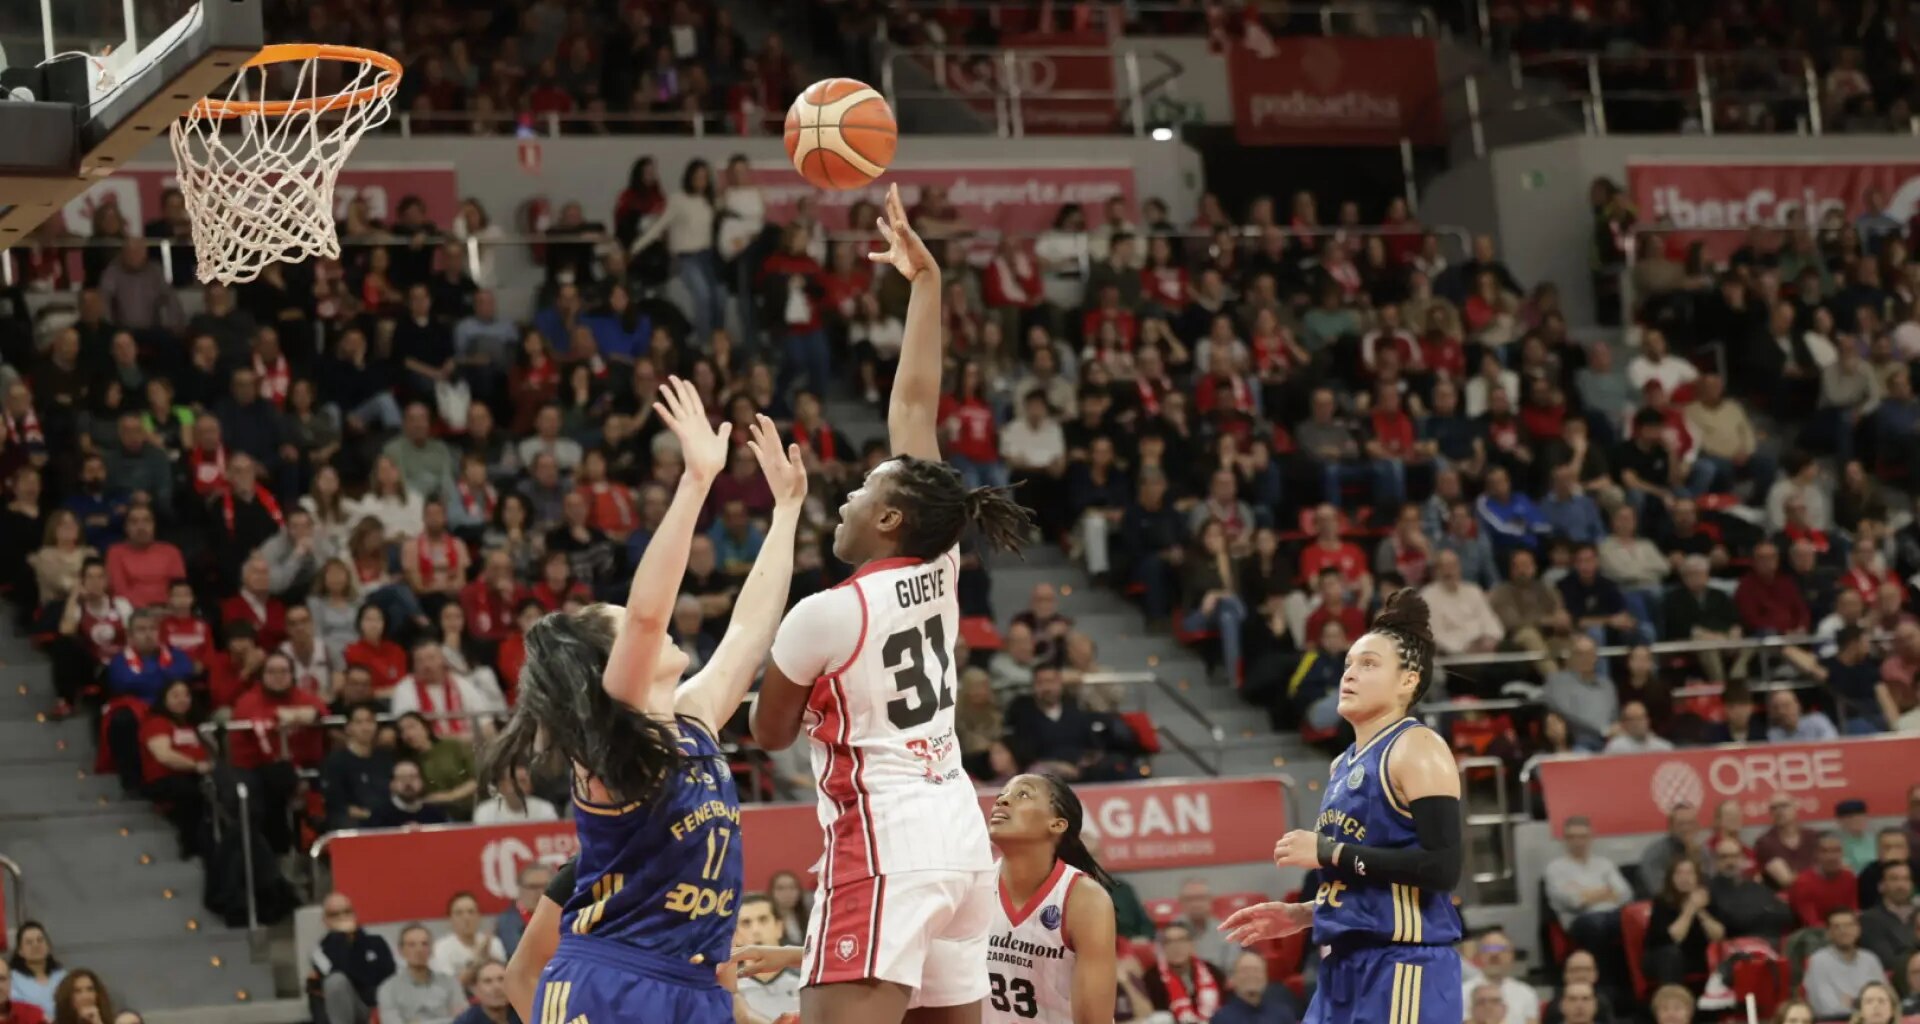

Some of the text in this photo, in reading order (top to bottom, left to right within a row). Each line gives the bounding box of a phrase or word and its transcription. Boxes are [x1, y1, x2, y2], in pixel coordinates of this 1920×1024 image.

[896, 568, 944, 608] GUEYE
[882, 614, 954, 730] 31
[1709, 750, 1848, 796] ORBE
[702, 827, 730, 881] 17
[987, 951, 1033, 969] ZARAGOZA
[988, 931, 1065, 959] ademont
[988, 972, 1038, 1019] 33
